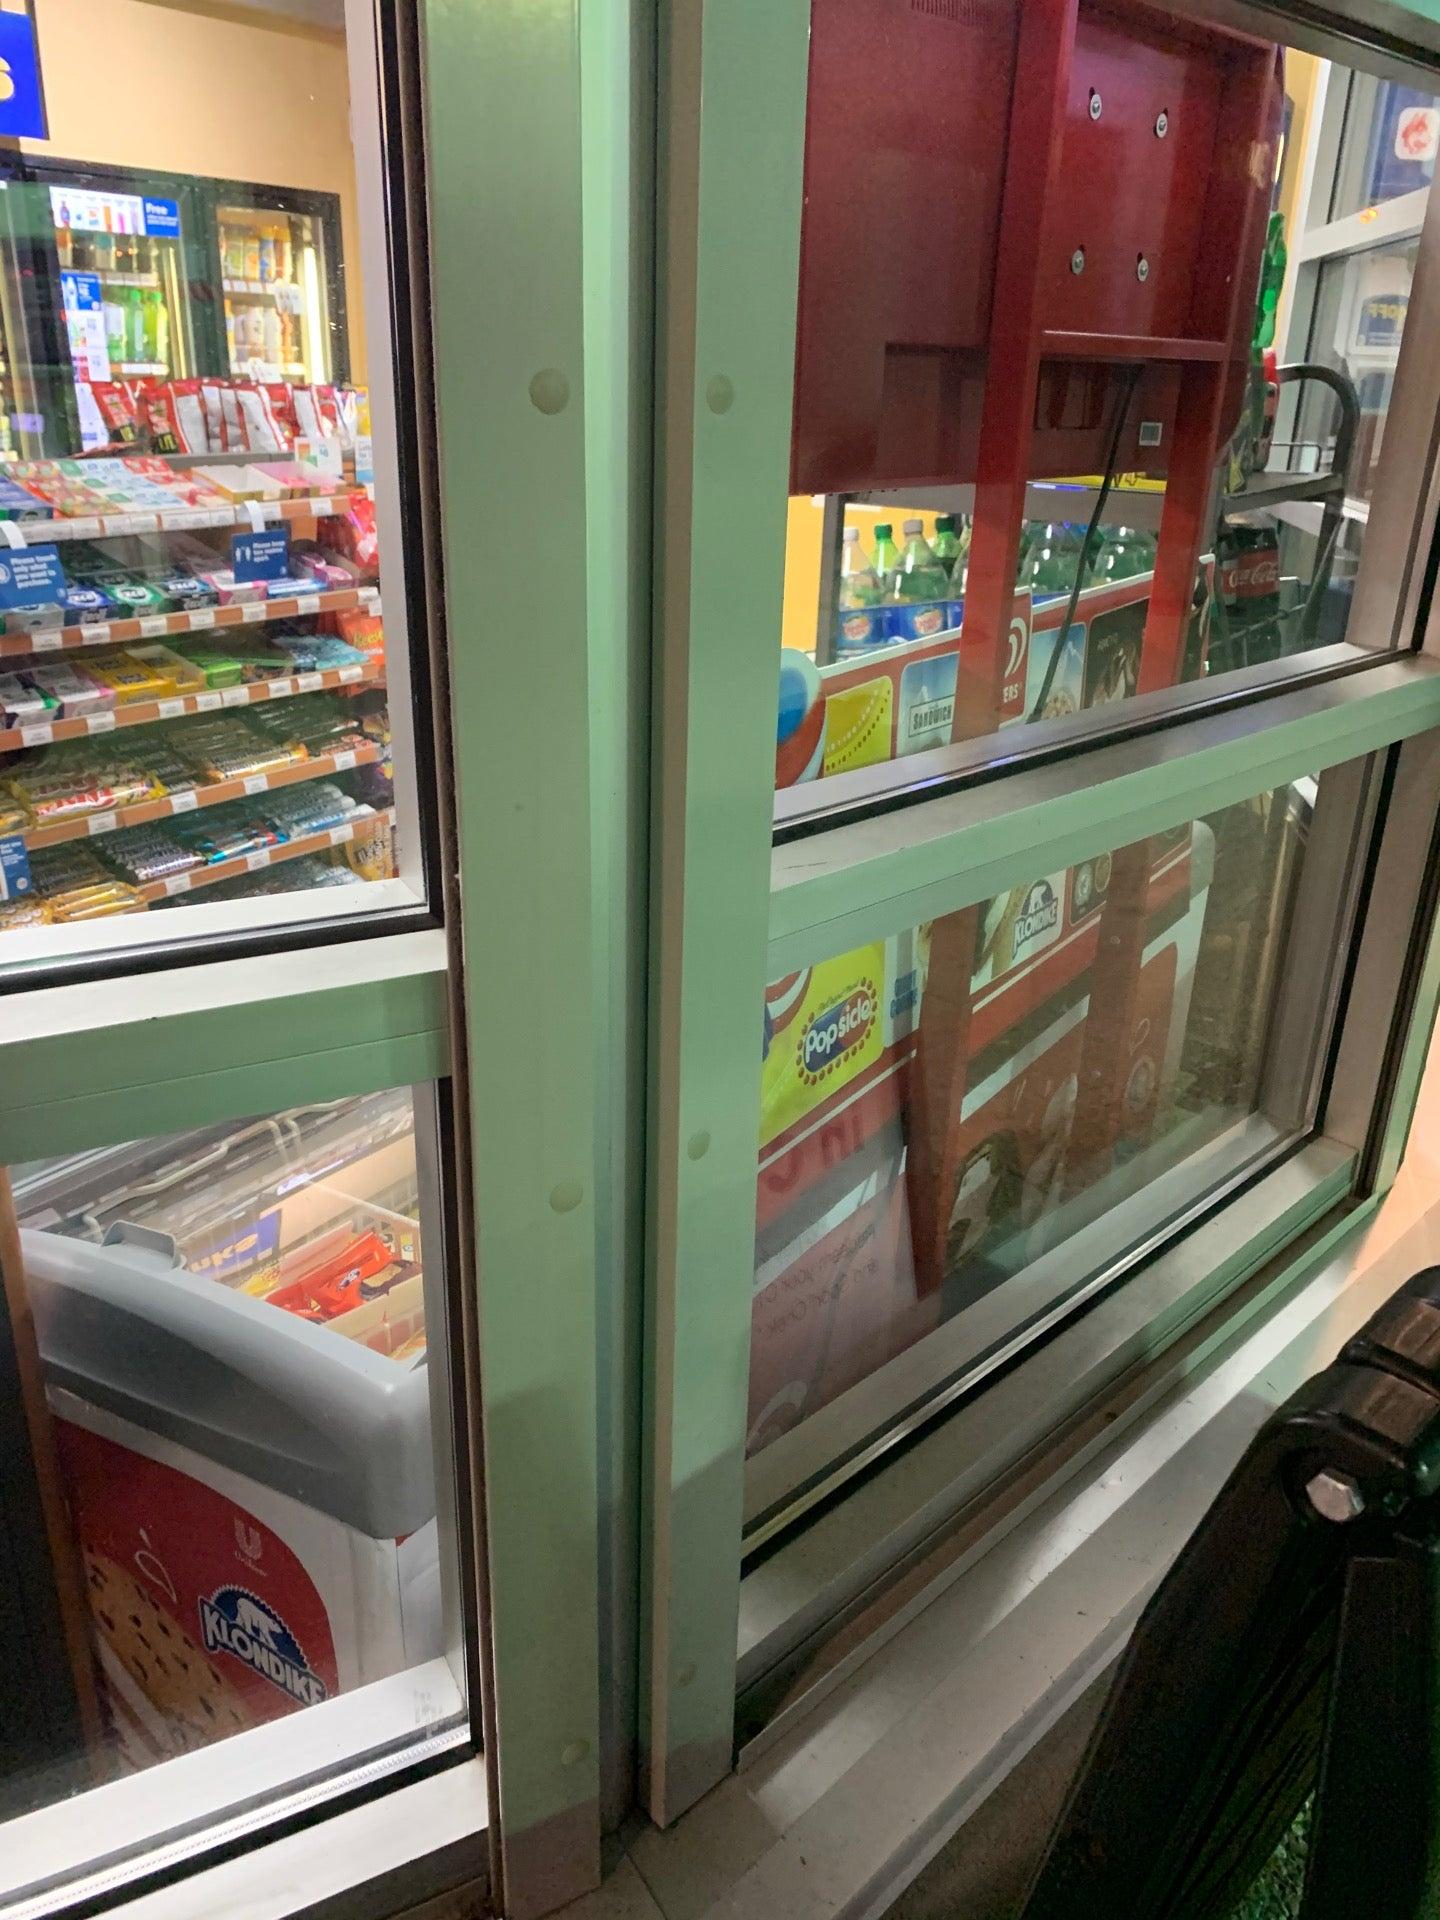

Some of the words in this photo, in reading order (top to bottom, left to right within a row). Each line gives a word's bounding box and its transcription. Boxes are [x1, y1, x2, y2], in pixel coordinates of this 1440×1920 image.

[145, 202, 169, 215] Free
[913, 704, 953, 731] SANDWICH
[202, 1603, 324, 1706] KLONDIKE
